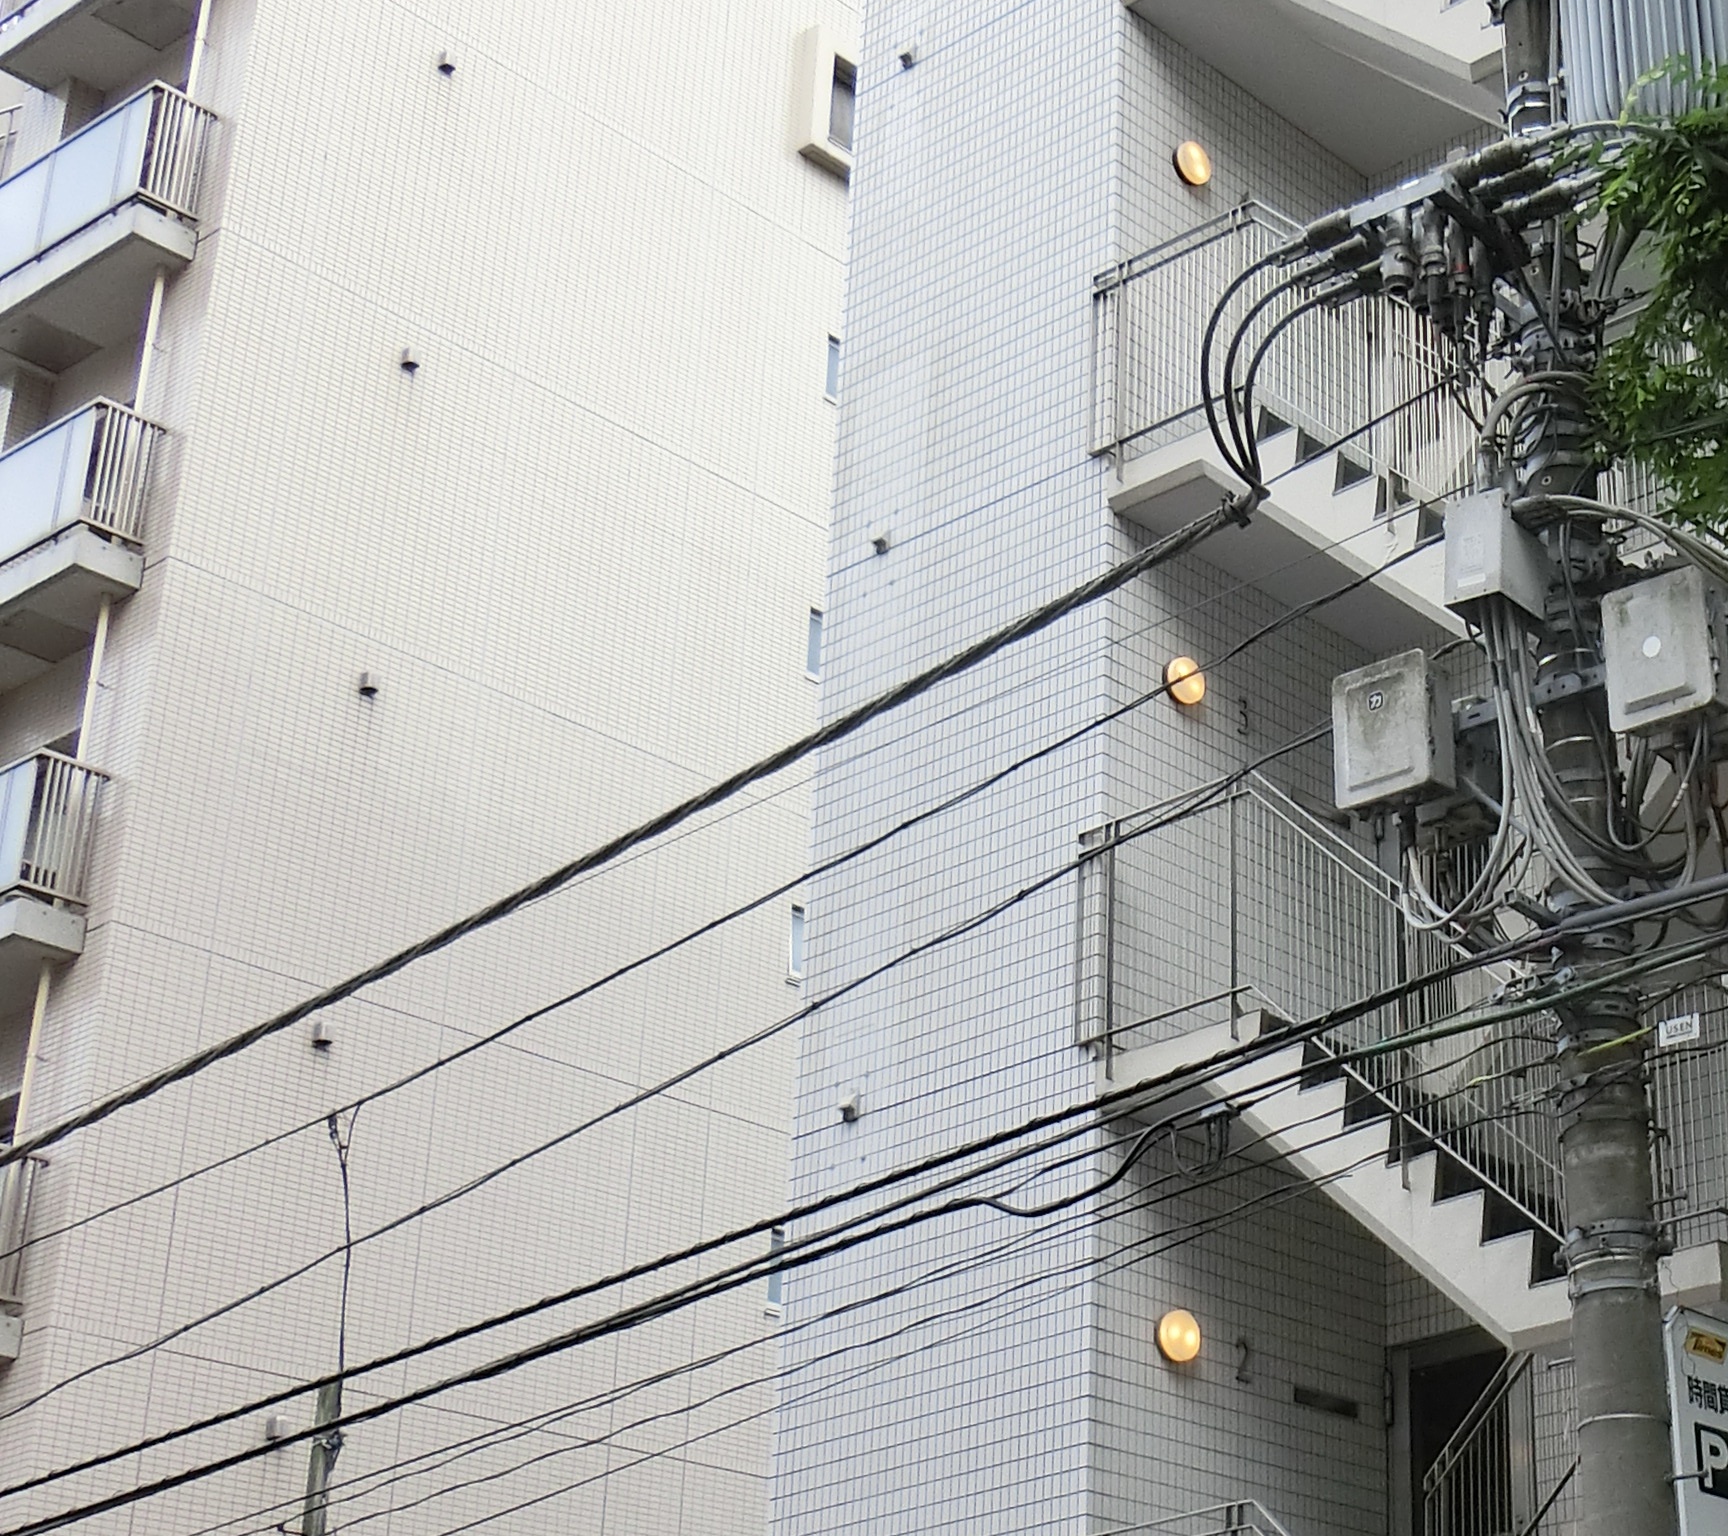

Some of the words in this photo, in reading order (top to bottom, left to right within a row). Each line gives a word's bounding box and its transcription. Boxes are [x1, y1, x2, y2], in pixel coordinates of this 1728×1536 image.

[1237, 698, 1249, 735] 3
[1666, 1021, 1693, 1035] USEN
[1235, 1337, 1251, 1384] 2
[1700, 1428, 1728, 1489] P
